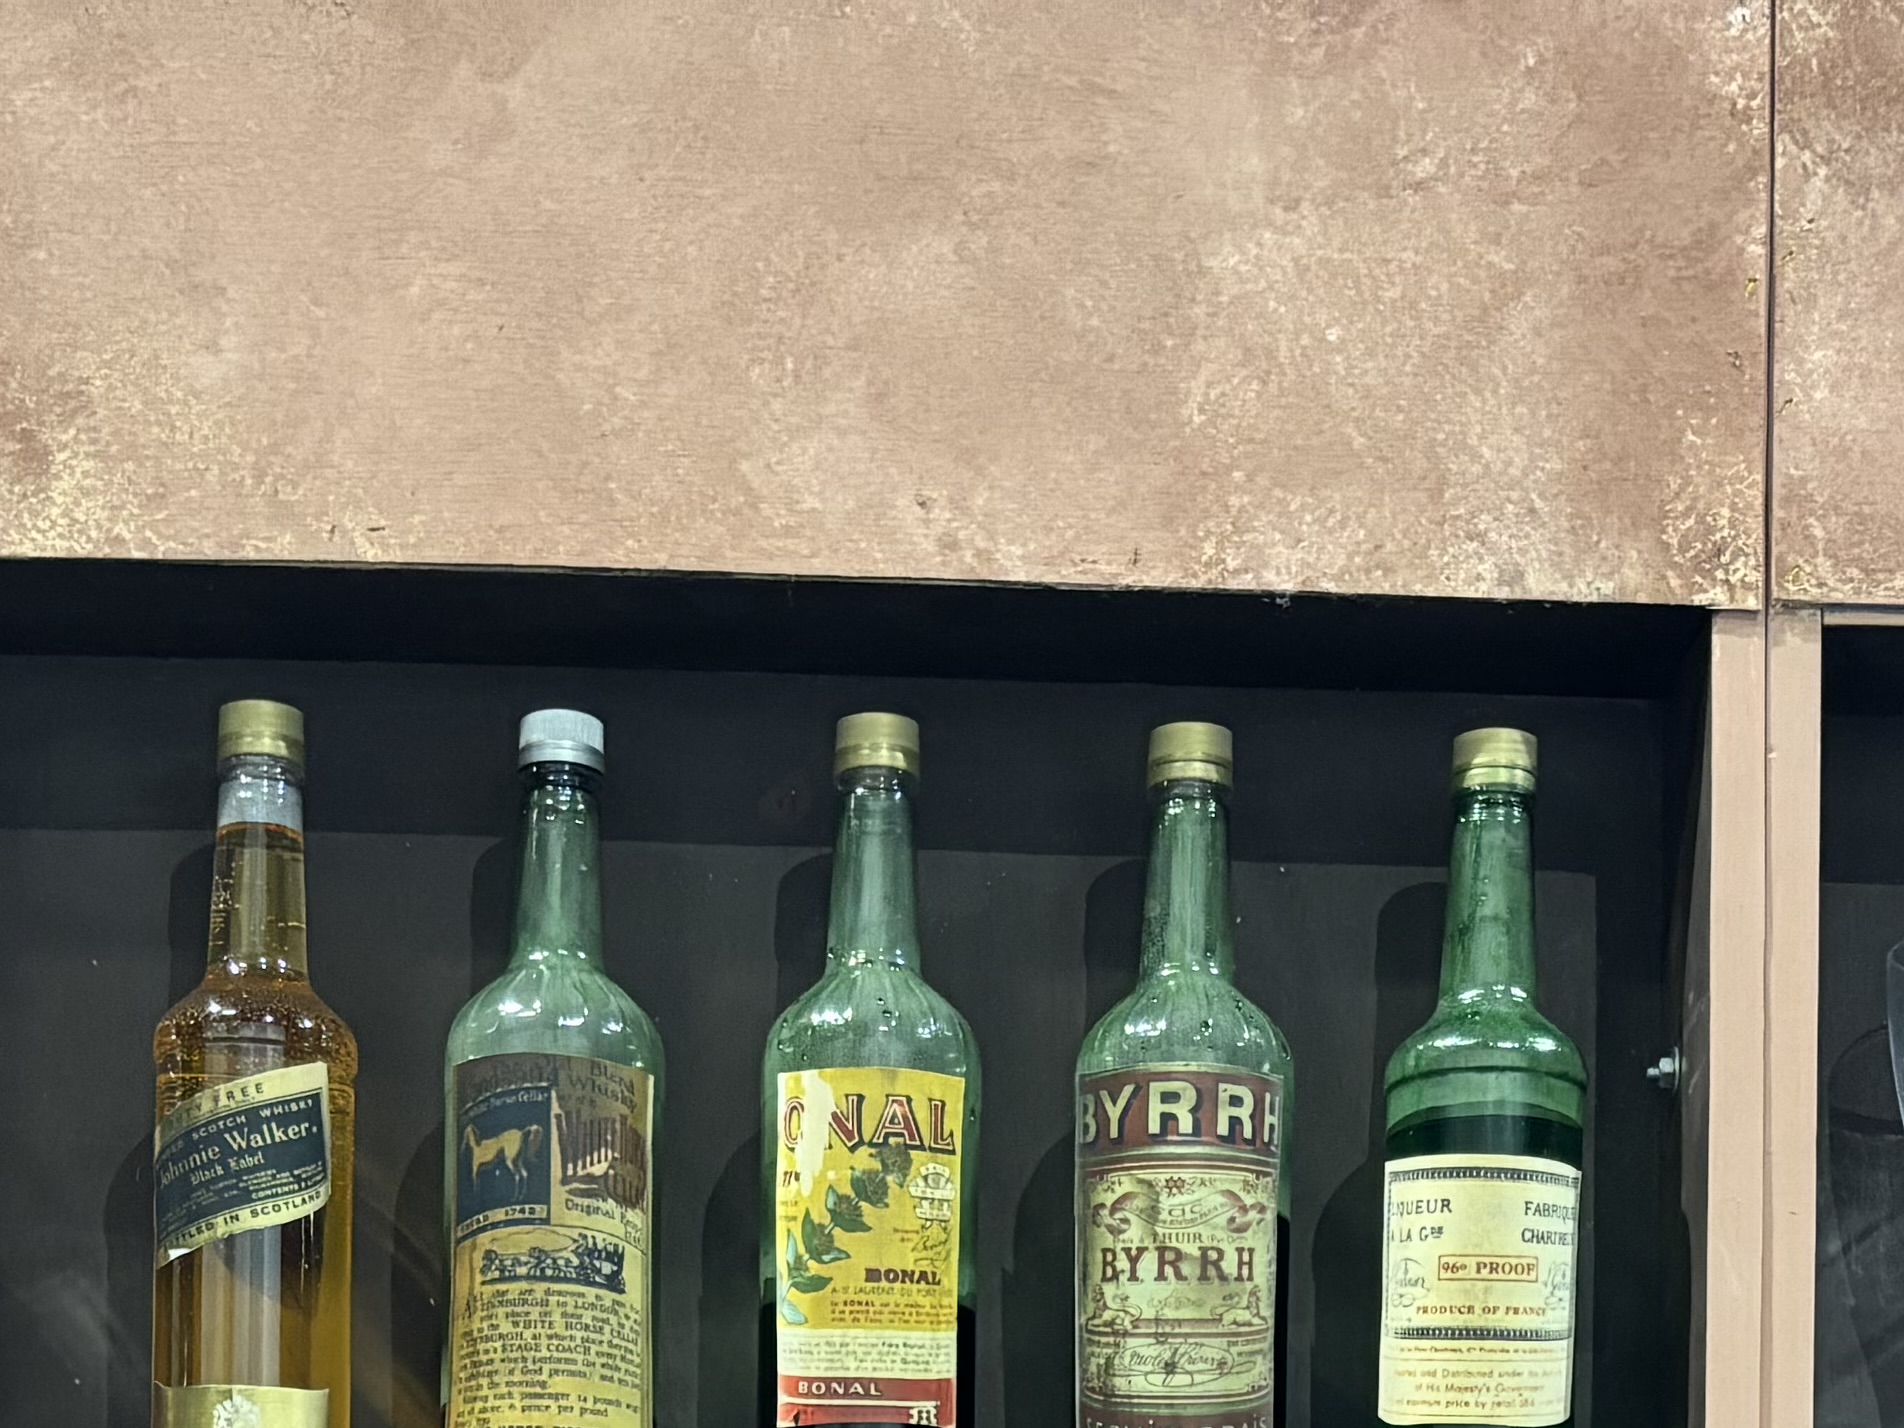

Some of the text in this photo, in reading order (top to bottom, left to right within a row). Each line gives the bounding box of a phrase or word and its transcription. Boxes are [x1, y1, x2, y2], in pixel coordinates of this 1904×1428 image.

[1079, 1079, 1280, 1145] BYRRH
[192, 1115, 246, 1140] SCOTCH
[159, 1145, 221, 1190] Johnnie
[191, 1162, 224, 1185] Black
[224, 1192, 322, 1226] IN SCOTLAND
[1152, 1232, 1203, 1245] THUIR
[864, 1268, 941, 1286] BONAL
[1101, 1246, 1256, 1286] BYRRH
[1475, 1261, 1536, 1276] PROOF
[798, 1381, 883, 1396] BONAL
